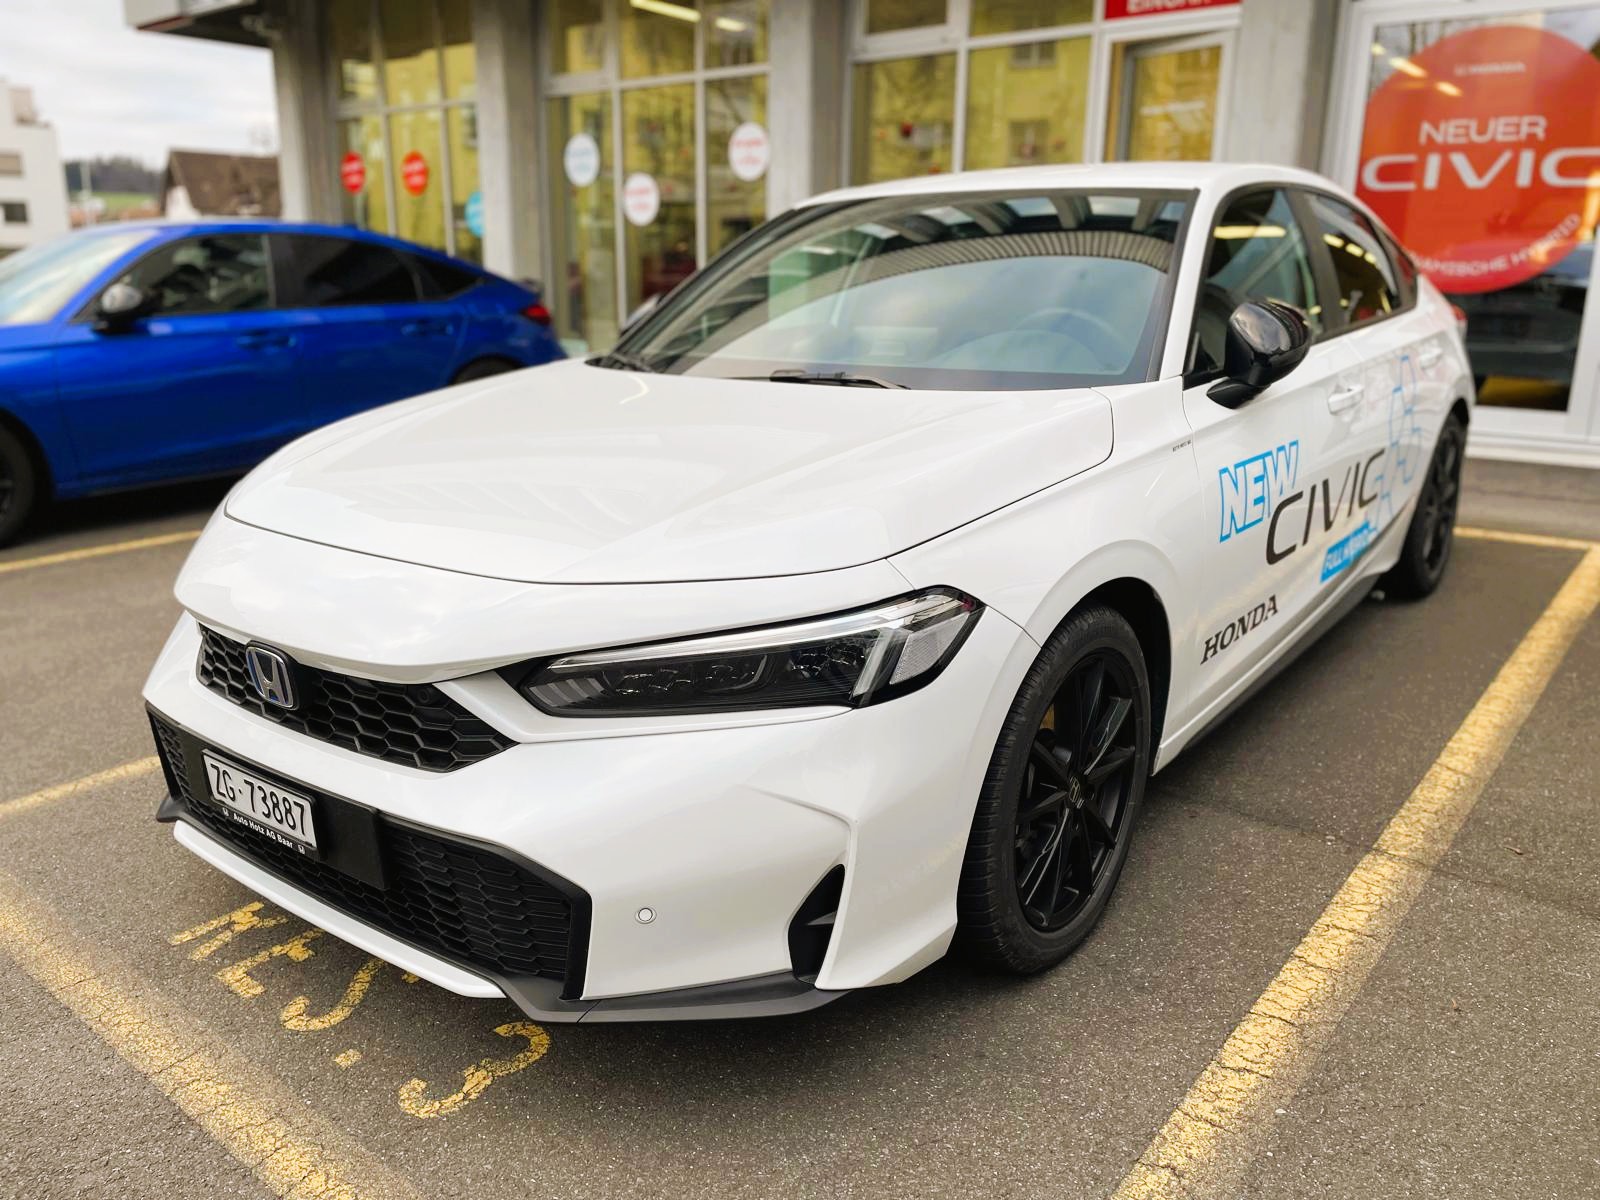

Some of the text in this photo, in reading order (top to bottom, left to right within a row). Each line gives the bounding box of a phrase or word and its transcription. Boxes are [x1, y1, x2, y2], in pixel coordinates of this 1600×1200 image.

[1419, 115, 1547, 146] NEUER
[1361, 147, 1600, 192] CIVIC
[1218, 439, 1299, 543] NEW
[1265, 447, 1386, 566] CIVIC
[1200, 595, 1279, 665] HONDA
[233, 812, 249, 826] Auto
[266, 829, 277, 840] AG
[276, 834, 293, 849] Baar
